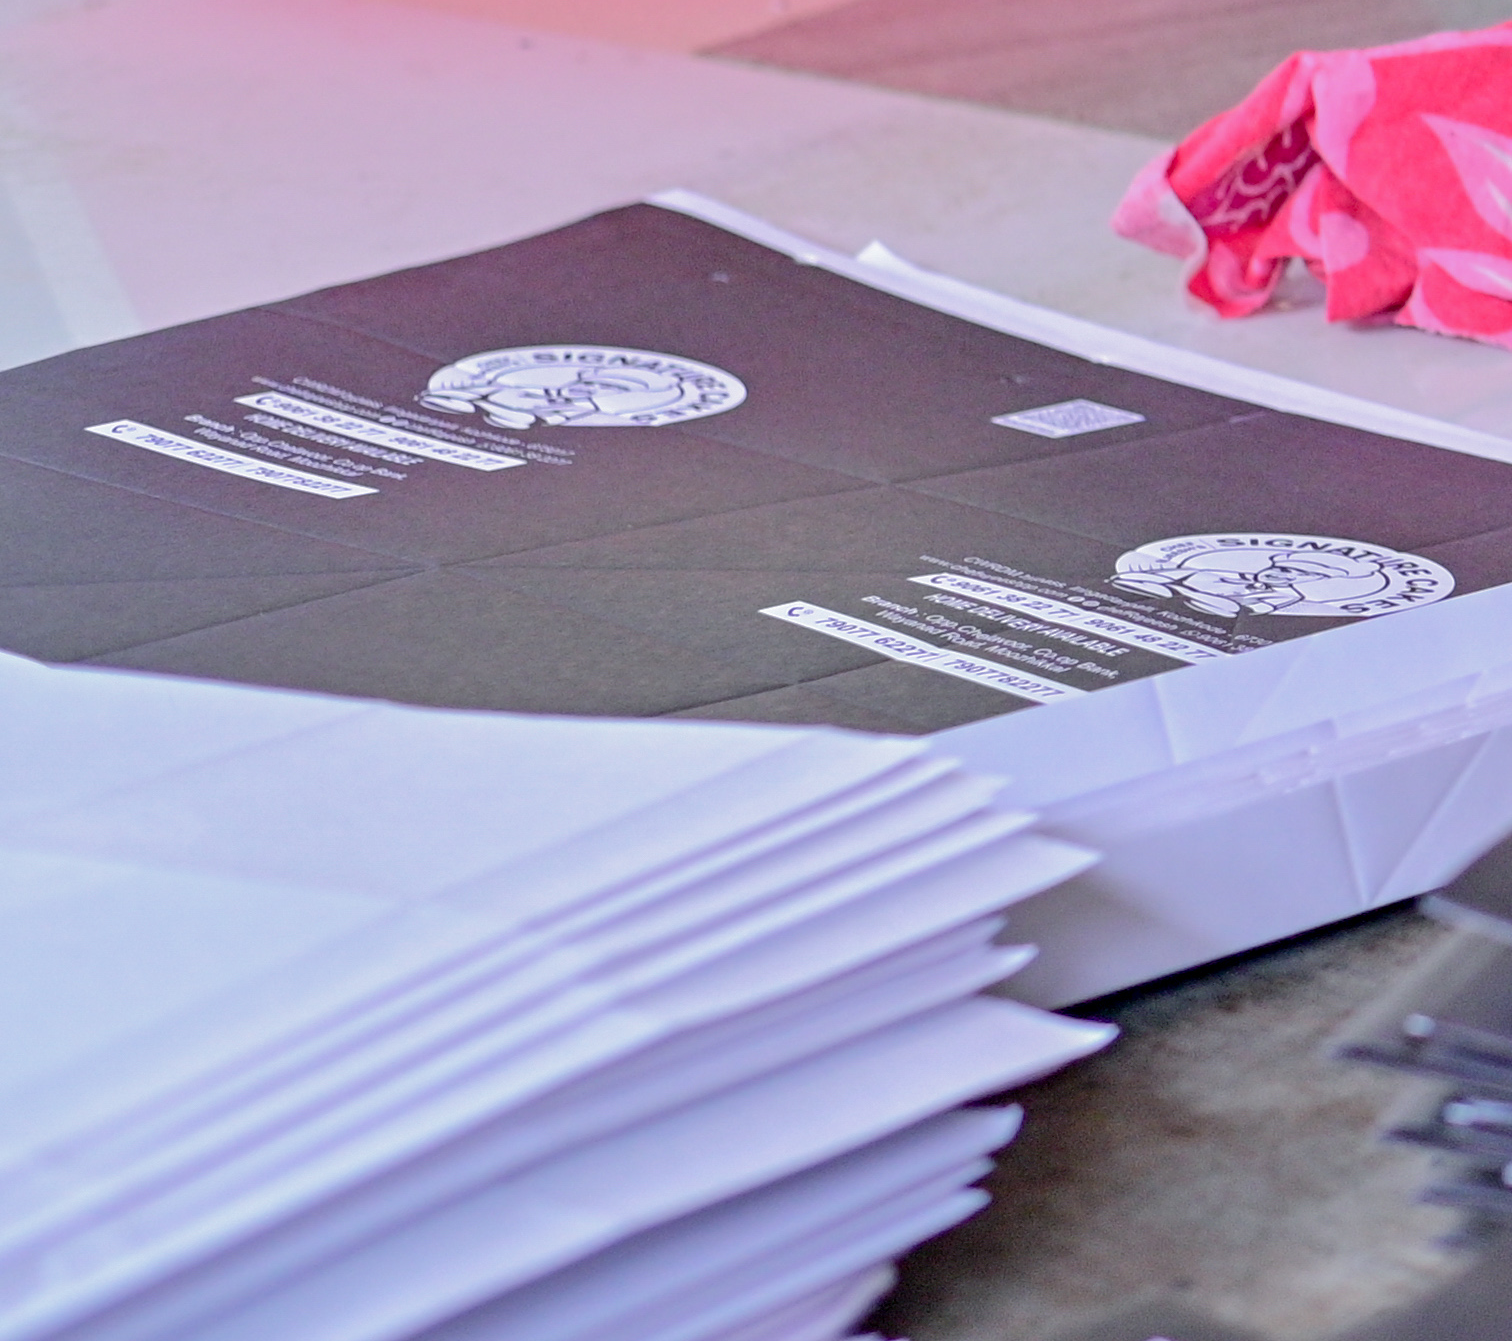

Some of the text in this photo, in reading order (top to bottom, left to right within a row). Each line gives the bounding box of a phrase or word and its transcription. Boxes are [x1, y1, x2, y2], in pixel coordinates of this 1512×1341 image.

[861, 594, 918, 617] Branch
[1217, 538, 1438, 615] SIGNATURE CAKES
[875, 609, 945, 636] Wayanad
[922, 592, 1130, 657] HOME DELIVERY AVAILABLE
[950, 580, 1218, 659] 9061 38 22 77 9061 48 22 77
[815, 616, 1066, 697] 79077 62277 7907782277
